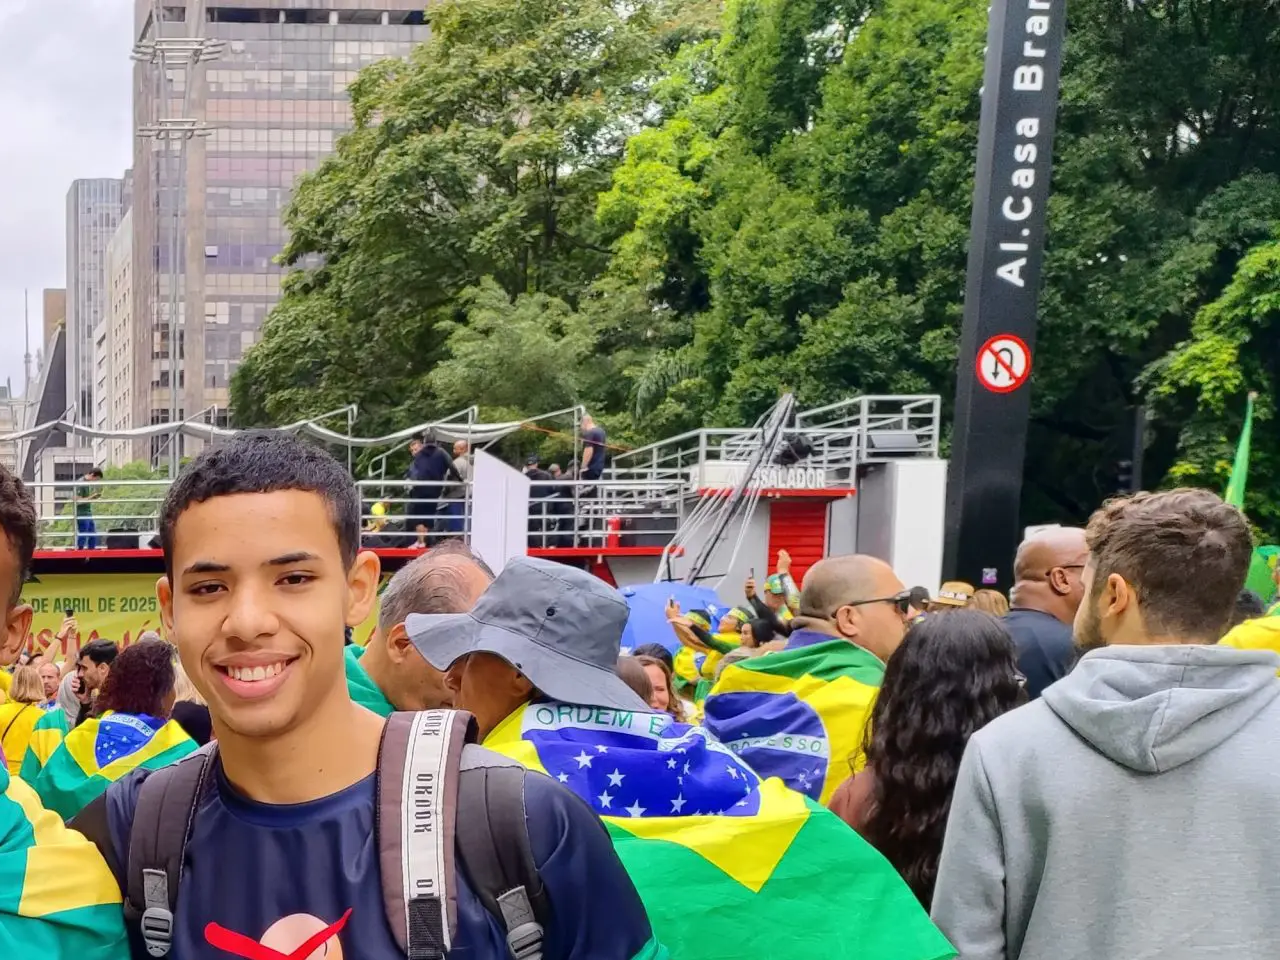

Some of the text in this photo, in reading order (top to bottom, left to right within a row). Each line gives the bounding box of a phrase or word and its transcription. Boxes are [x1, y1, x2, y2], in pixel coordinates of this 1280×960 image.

[31, 598, 49, 613] DE
[53, 597, 94, 613] ABRIL
[98, 597, 117, 613] DE
[120, 596, 157, 612] 2025
[536, 704, 633, 729] ORDEM
